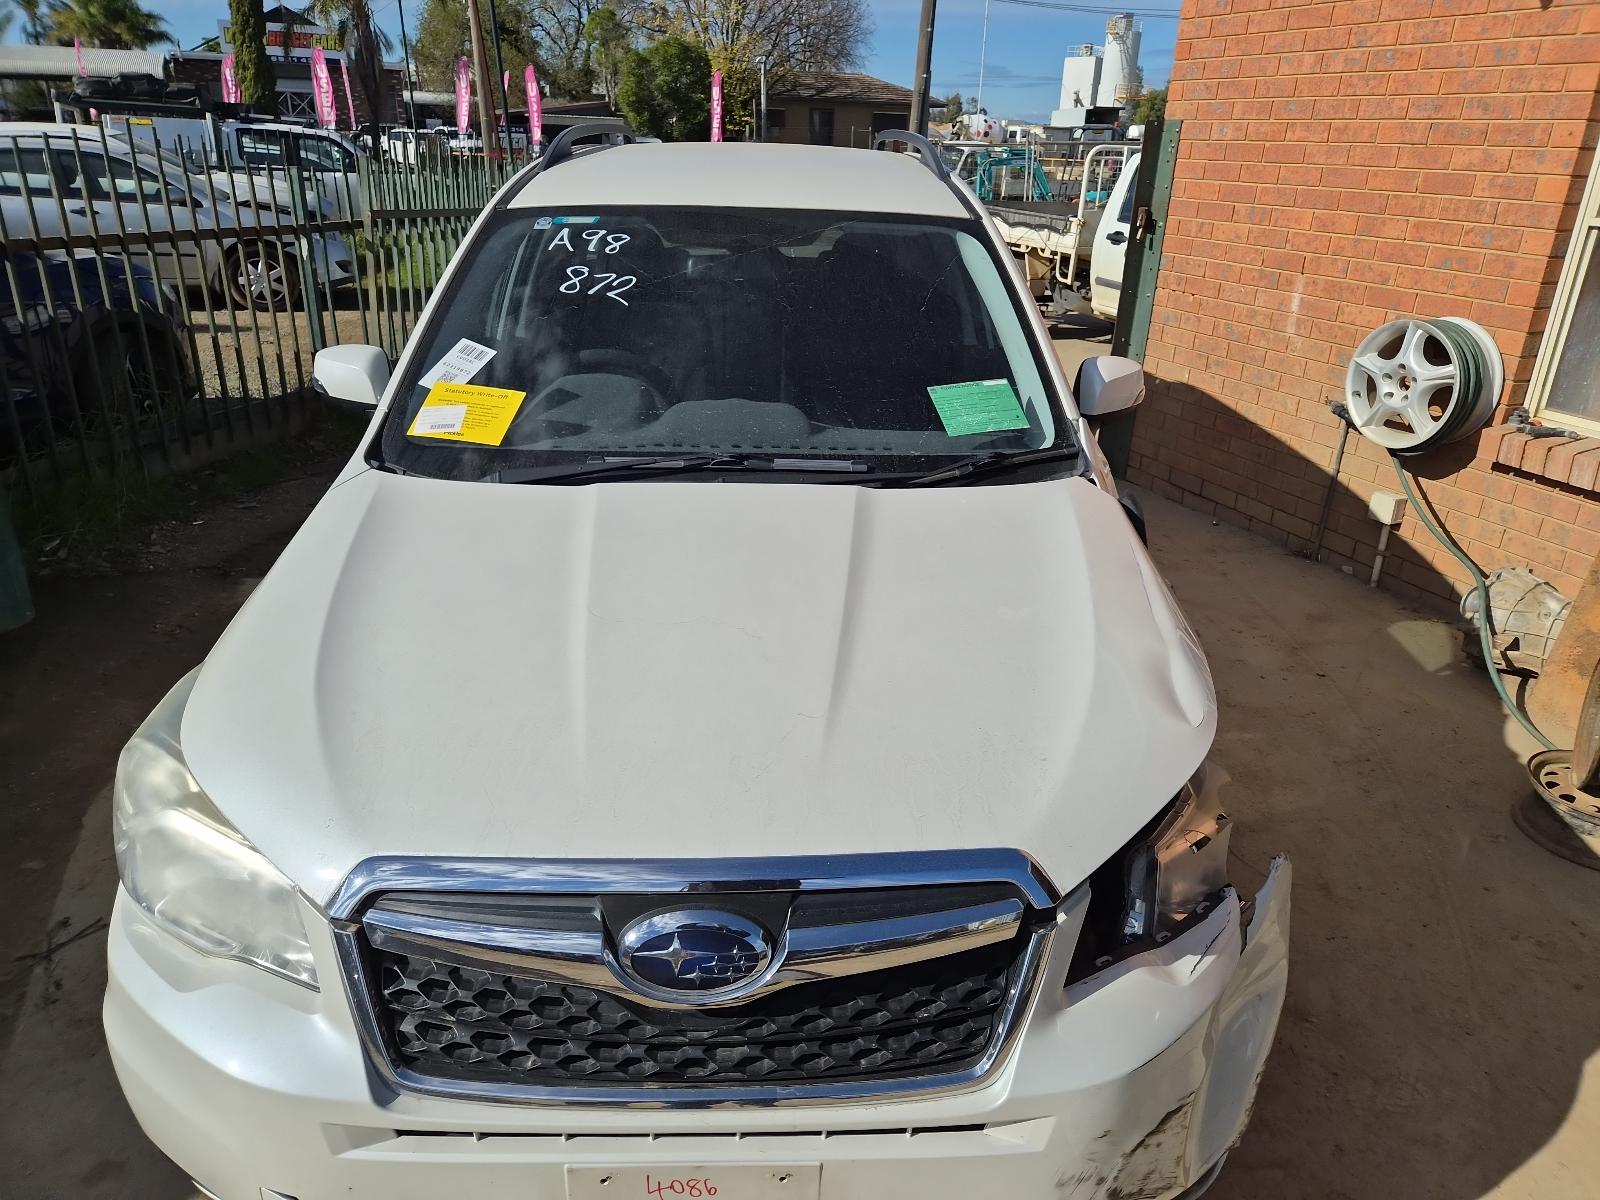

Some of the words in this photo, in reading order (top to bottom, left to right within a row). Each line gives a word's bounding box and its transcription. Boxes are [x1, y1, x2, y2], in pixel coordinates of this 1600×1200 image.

[268, 31, 312, 48] BUGET
[316, 64, 332, 120] USED
[459, 74, 471, 132] USED
[527, 82, 541, 141] USED
[559, 266, 637, 306] 872
[444, 388, 476, 397] Statutory
[477, 392, 509, 400] Write-Off
[647, 1175, 717, 1200] 4086
